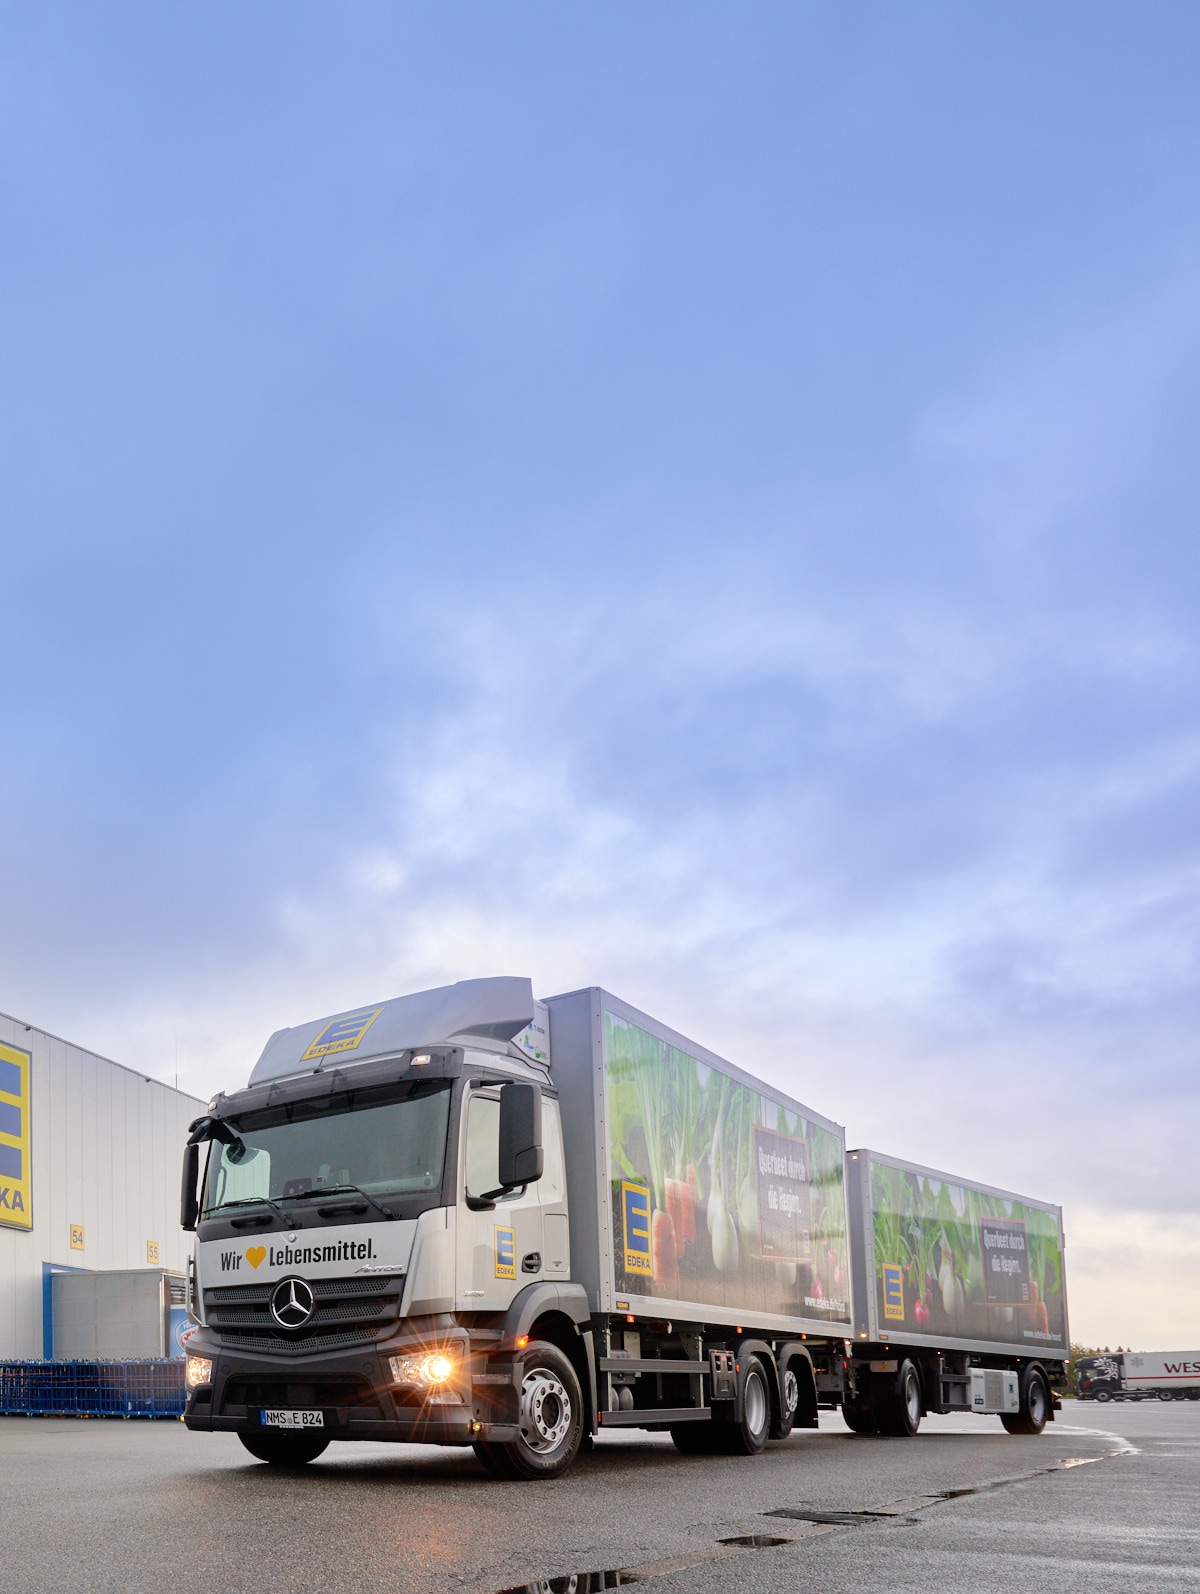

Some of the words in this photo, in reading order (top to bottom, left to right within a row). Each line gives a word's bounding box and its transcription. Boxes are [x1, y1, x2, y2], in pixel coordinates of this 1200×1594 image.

[308, 1040, 355, 1056] EDEKA
[72, 1230, 84, 1245] 54
[148, 1245, 159, 1259] 55
[221, 1251, 243, 1271] Wir
[269, 1238, 378, 1267] Lebensmittel.
[627, 1255, 651, 1270] EDEKA
[497, 1267, 515, 1275] EDEKA
[266, 1412, 287, 1424] NMS
[292, 1412, 300, 1425] E
[302, 1412, 322, 1425] 824
